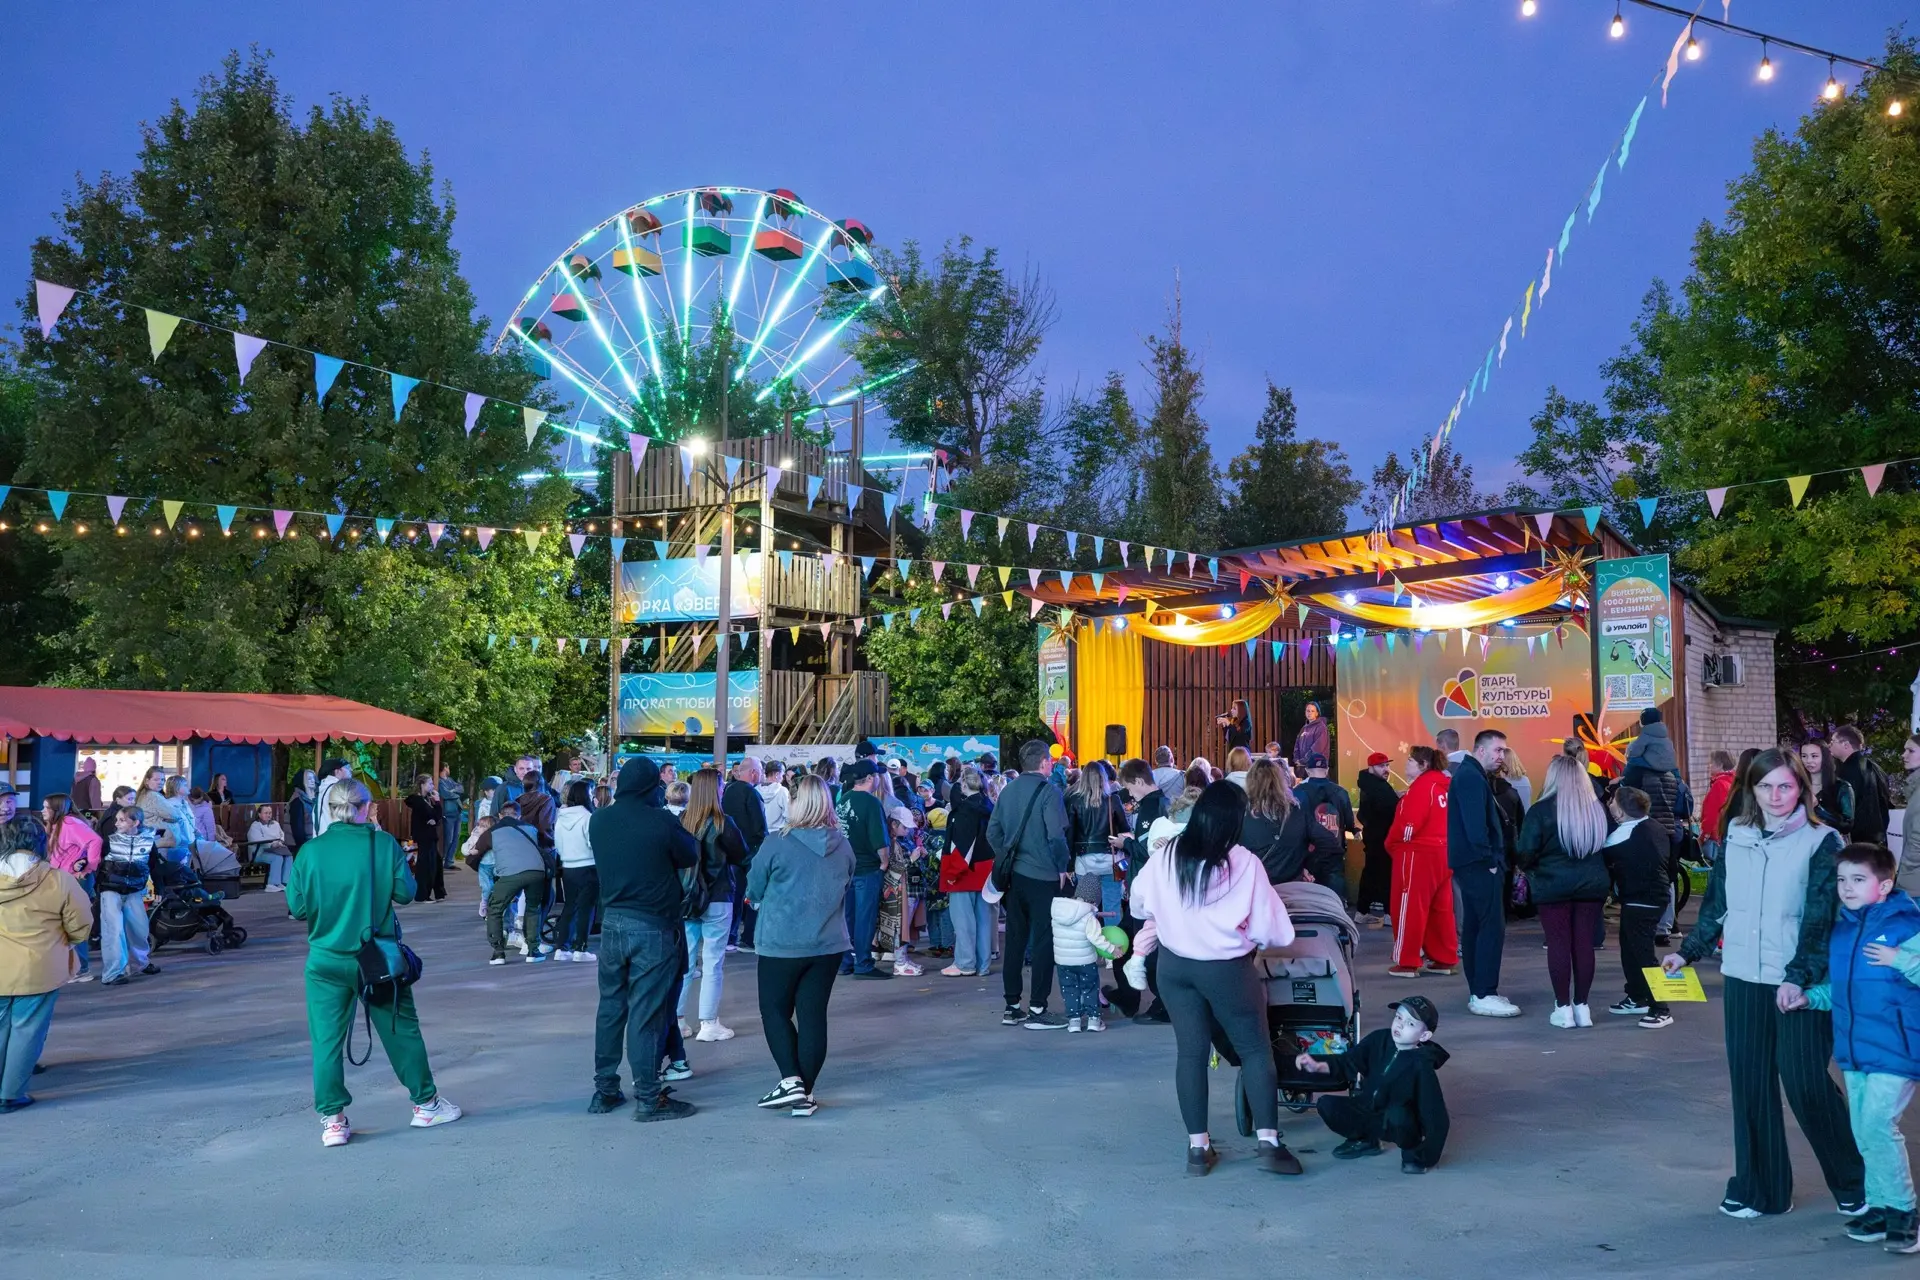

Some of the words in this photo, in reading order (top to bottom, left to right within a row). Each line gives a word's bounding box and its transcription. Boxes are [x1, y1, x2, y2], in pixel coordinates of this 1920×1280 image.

[1603, 598, 1624, 606] 1000
[1625, 595, 1662, 605] ЛИТРОВ
[1610, 604, 1653, 614] БЕНЗИНА!
[1613, 622, 1648, 631] УРАЛОЙЛ
[1481, 676, 1515, 687] ПАРК
[1482, 689, 1550, 701] КУЛЬТУРЫ
[623, 697, 672, 710] ПРОКАТ
[675, 696, 752, 710] ТЮБИГОВ
[1494, 704, 1548, 715] ОТДЫХА
